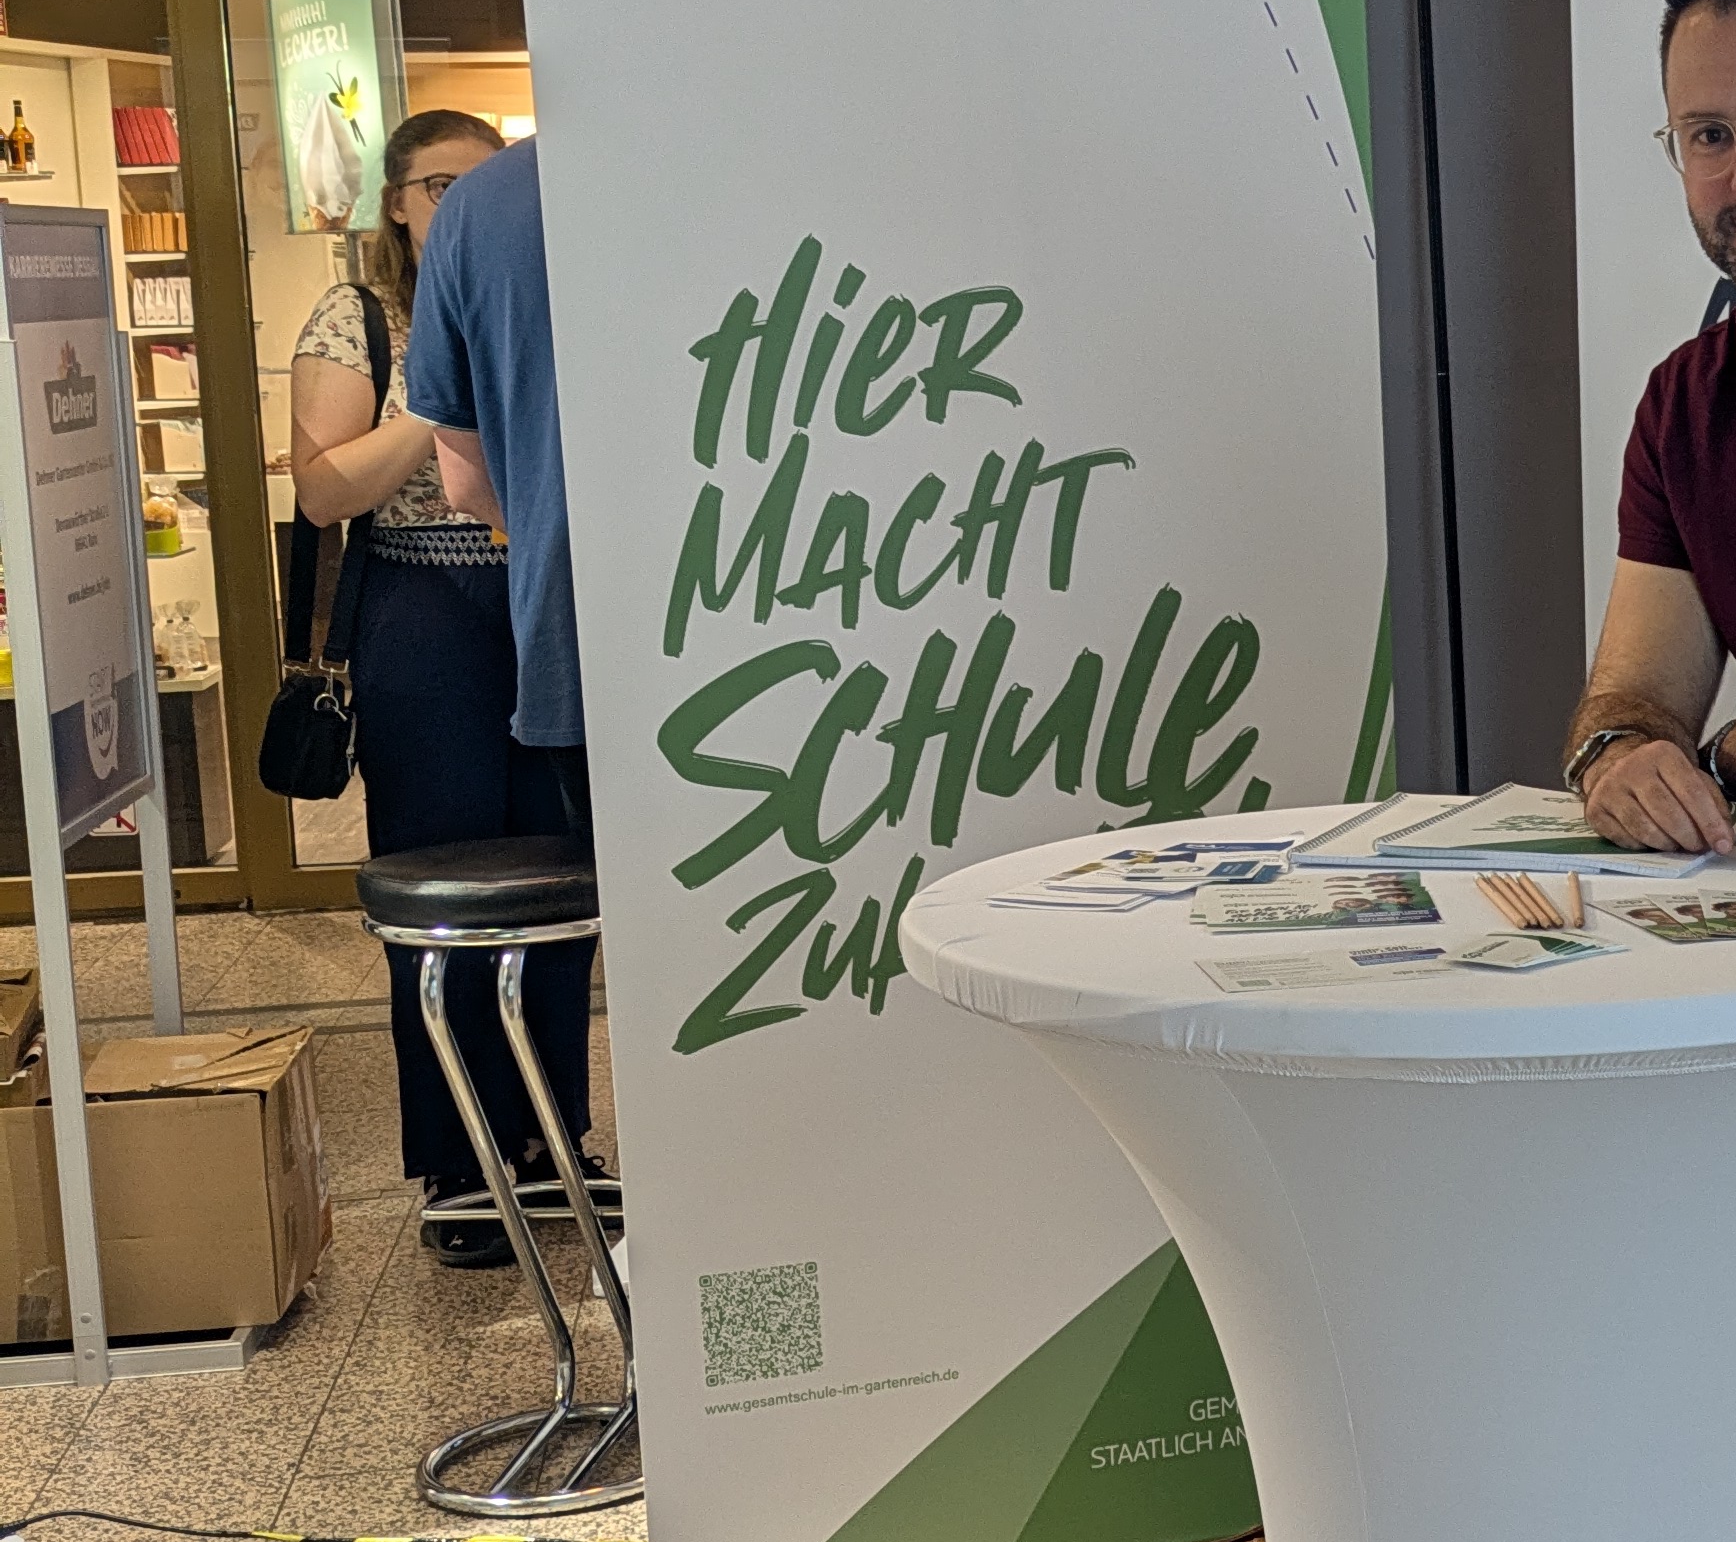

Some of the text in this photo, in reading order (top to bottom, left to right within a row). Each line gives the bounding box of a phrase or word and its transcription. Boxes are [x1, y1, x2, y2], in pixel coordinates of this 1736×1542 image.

[279, 22, 349, 68] LECKER!
[52, 387, 95, 424] Dehner
[663, 428, 1136, 658] MACHT
[705, 1369, 959, 1415] www.gesamtschule-im-gartenreich.de
[1189, 1396, 1240, 1421] GEM
[1090, 1429, 1213, 1469] STAATLICH
